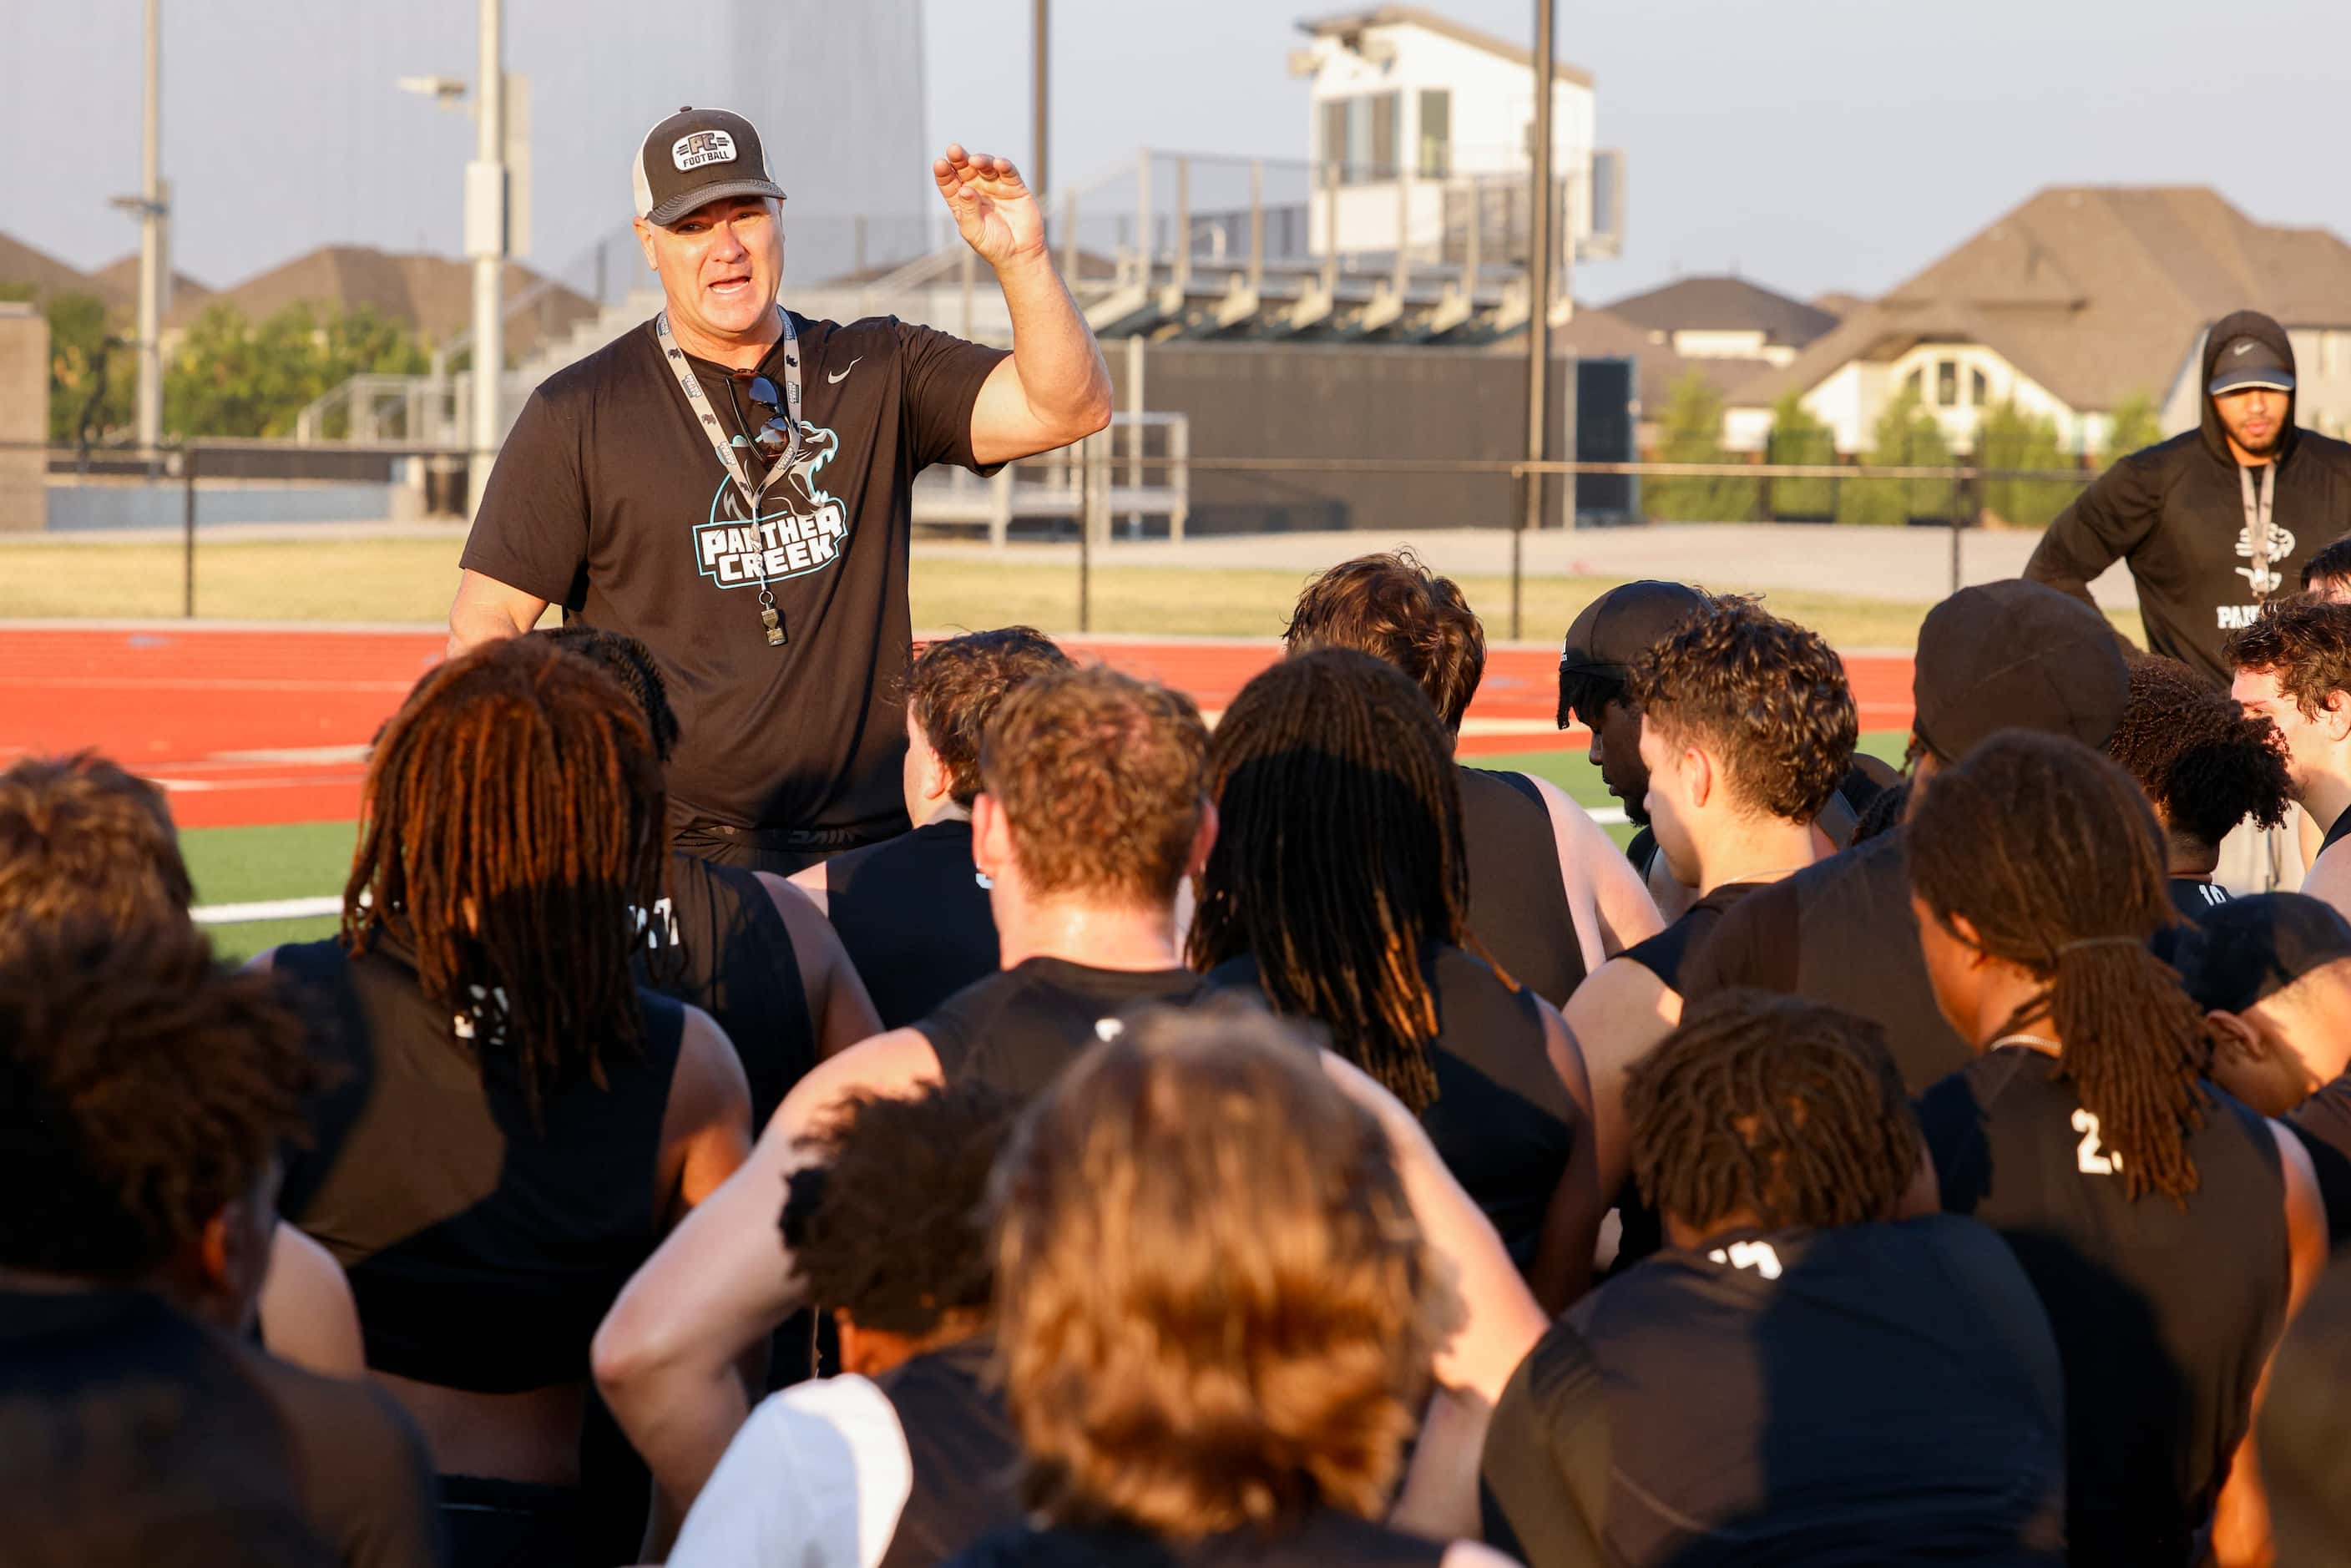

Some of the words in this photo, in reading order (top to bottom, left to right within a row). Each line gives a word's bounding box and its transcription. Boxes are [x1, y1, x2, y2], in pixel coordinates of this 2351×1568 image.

[688, 133, 717, 154] PC
[683, 150, 730, 167] FOOTBALL
[719, 534, 834, 581] CREEK
